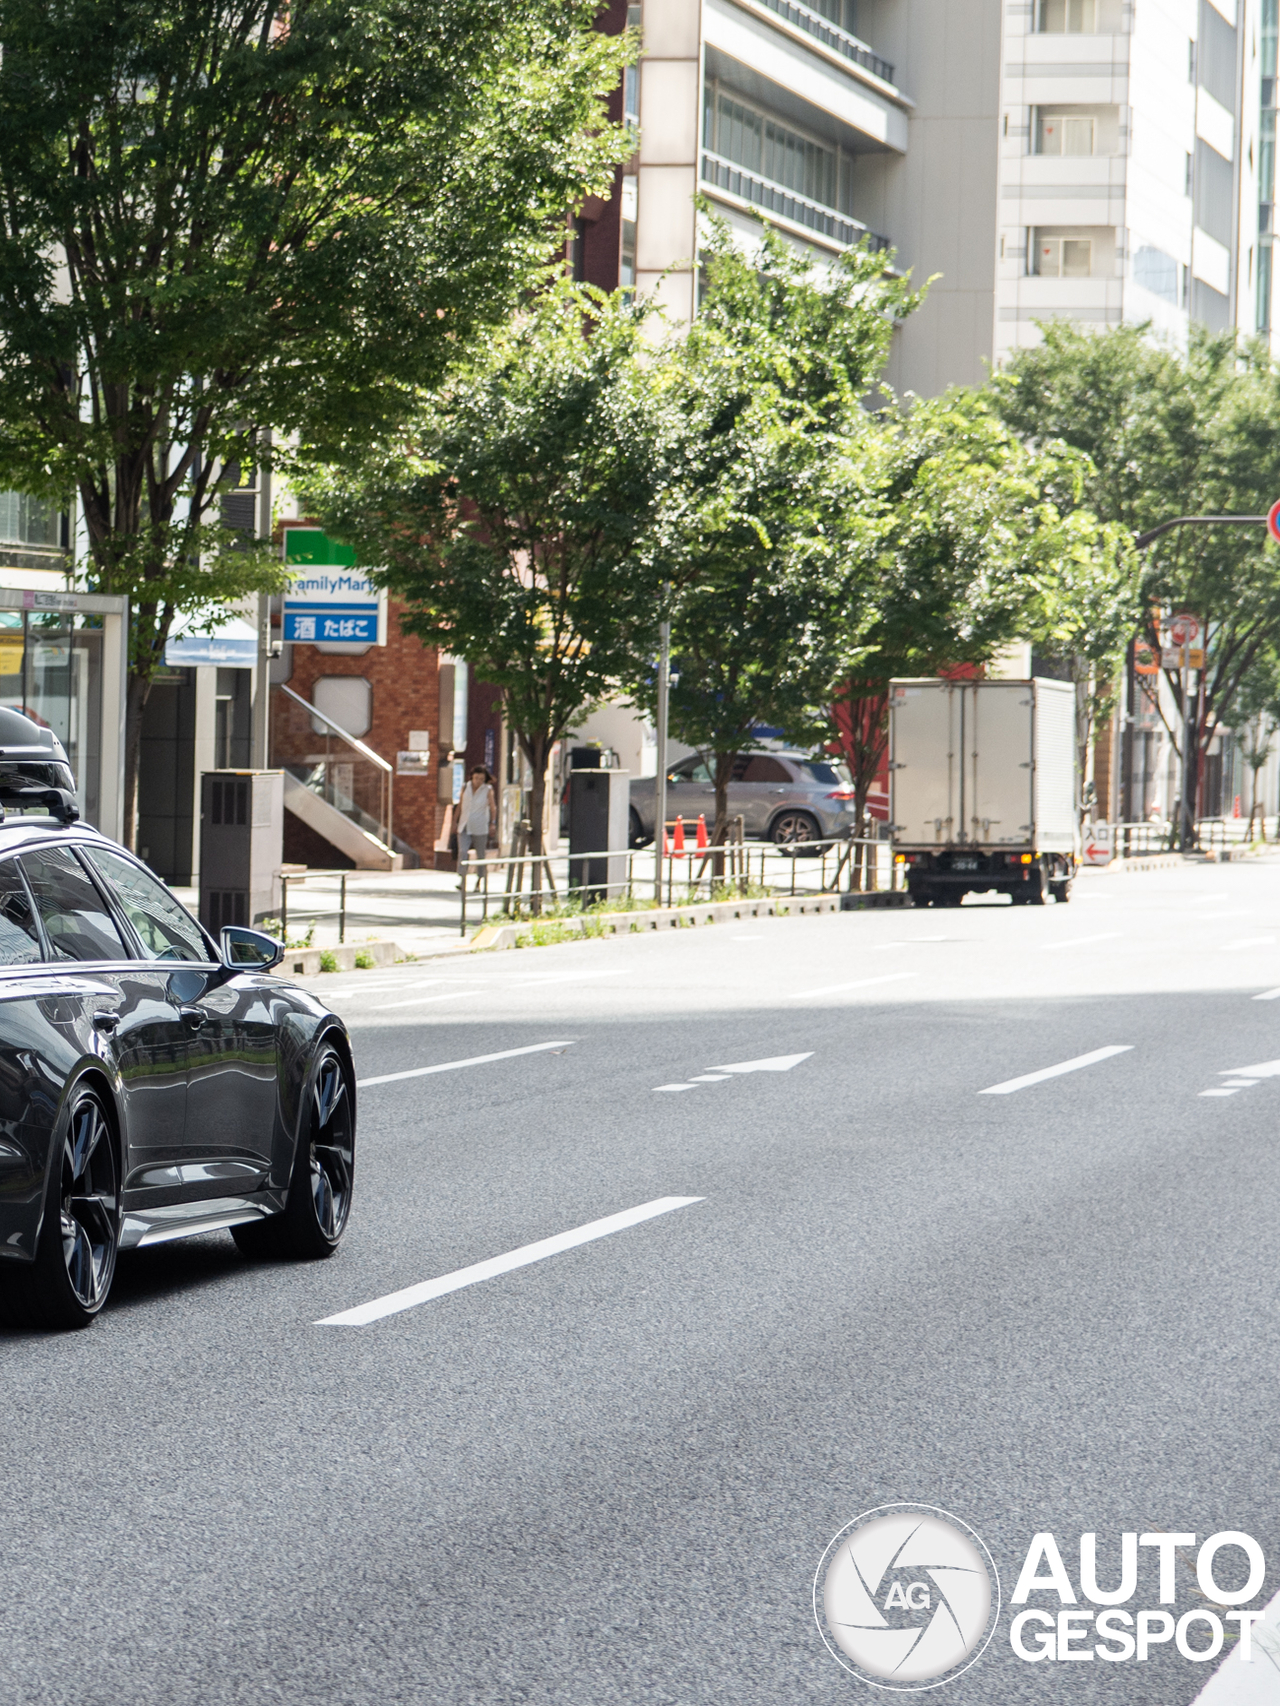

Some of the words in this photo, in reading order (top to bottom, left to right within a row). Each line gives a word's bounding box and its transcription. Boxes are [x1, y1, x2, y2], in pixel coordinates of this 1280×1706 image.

[293, 616, 316, 640] 酒
[323, 619, 369, 637] たばこ
[1084, 827, 1108, 841] 入口
